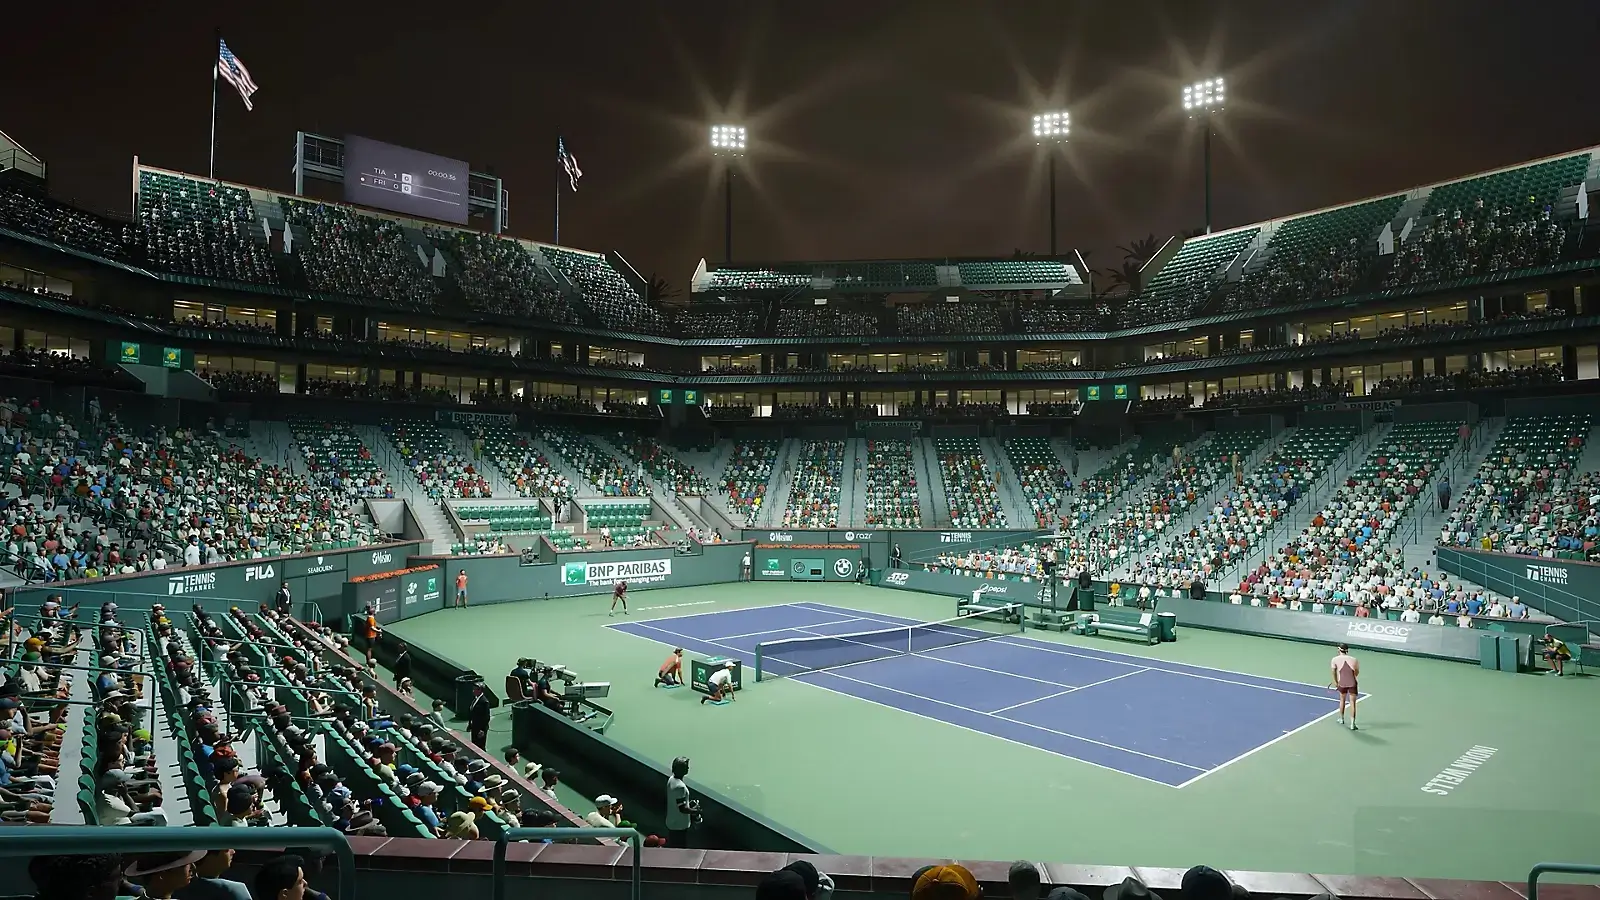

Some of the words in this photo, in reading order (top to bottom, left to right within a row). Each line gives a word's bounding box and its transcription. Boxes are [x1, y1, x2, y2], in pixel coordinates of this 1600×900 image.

[374, 167, 386, 176] TIA
[373, 178, 386, 186] FRI
[855, 532, 873, 540] razr
[245, 564, 275, 582] FILA
[307, 565, 333, 574] SEABOURN
[589, 565, 615, 578] BNP
[617, 561, 666, 576] PARIBAS
[1539, 565, 1568, 579] TENNIS
[184, 572, 216, 587] TENNIS
[599, 578, 614, 586] bank
[627, 575, 651, 584] changing
[887, 572, 910, 581] ATP
[184, 584, 216, 593] CHANNEL
[1348, 621, 1410, 636] HOLOGIC
[1450, 744, 1499, 771] INDIAN
[1420, 768, 1472, 796] WELLS
